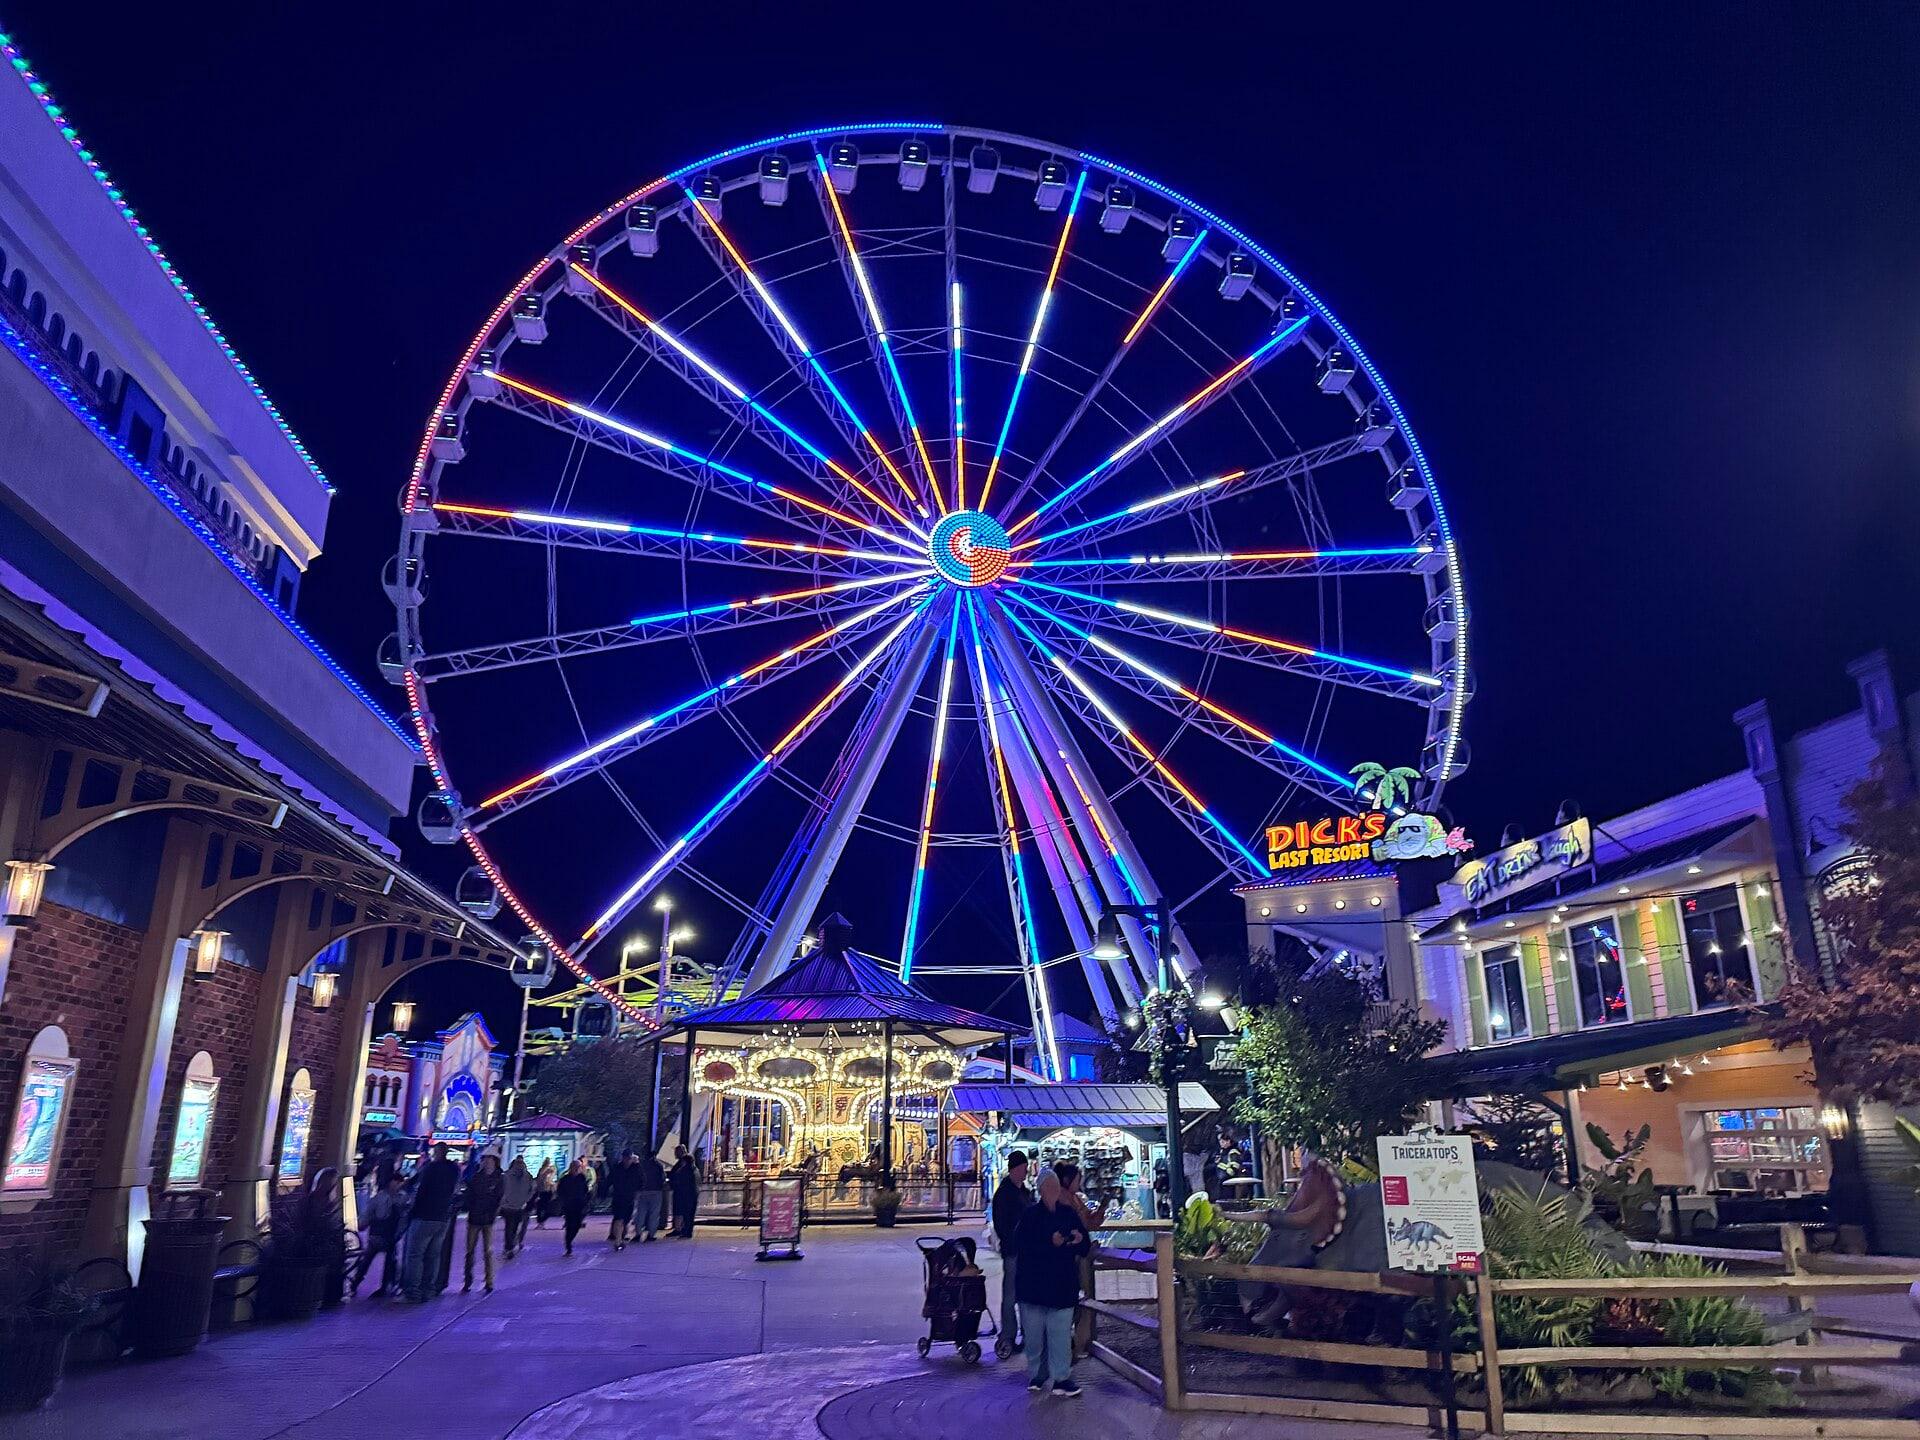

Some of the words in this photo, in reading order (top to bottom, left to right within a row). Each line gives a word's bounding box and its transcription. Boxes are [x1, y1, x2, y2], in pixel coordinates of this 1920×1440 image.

[1265, 813, 1386, 852] DICK'S
[1268, 849, 1309, 870] LAST
[1310, 842, 1370, 864] RESORT
[1465, 857, 1498, 902] EAT
[1391, 1146, 1459, 1160] TRICERATOPS
